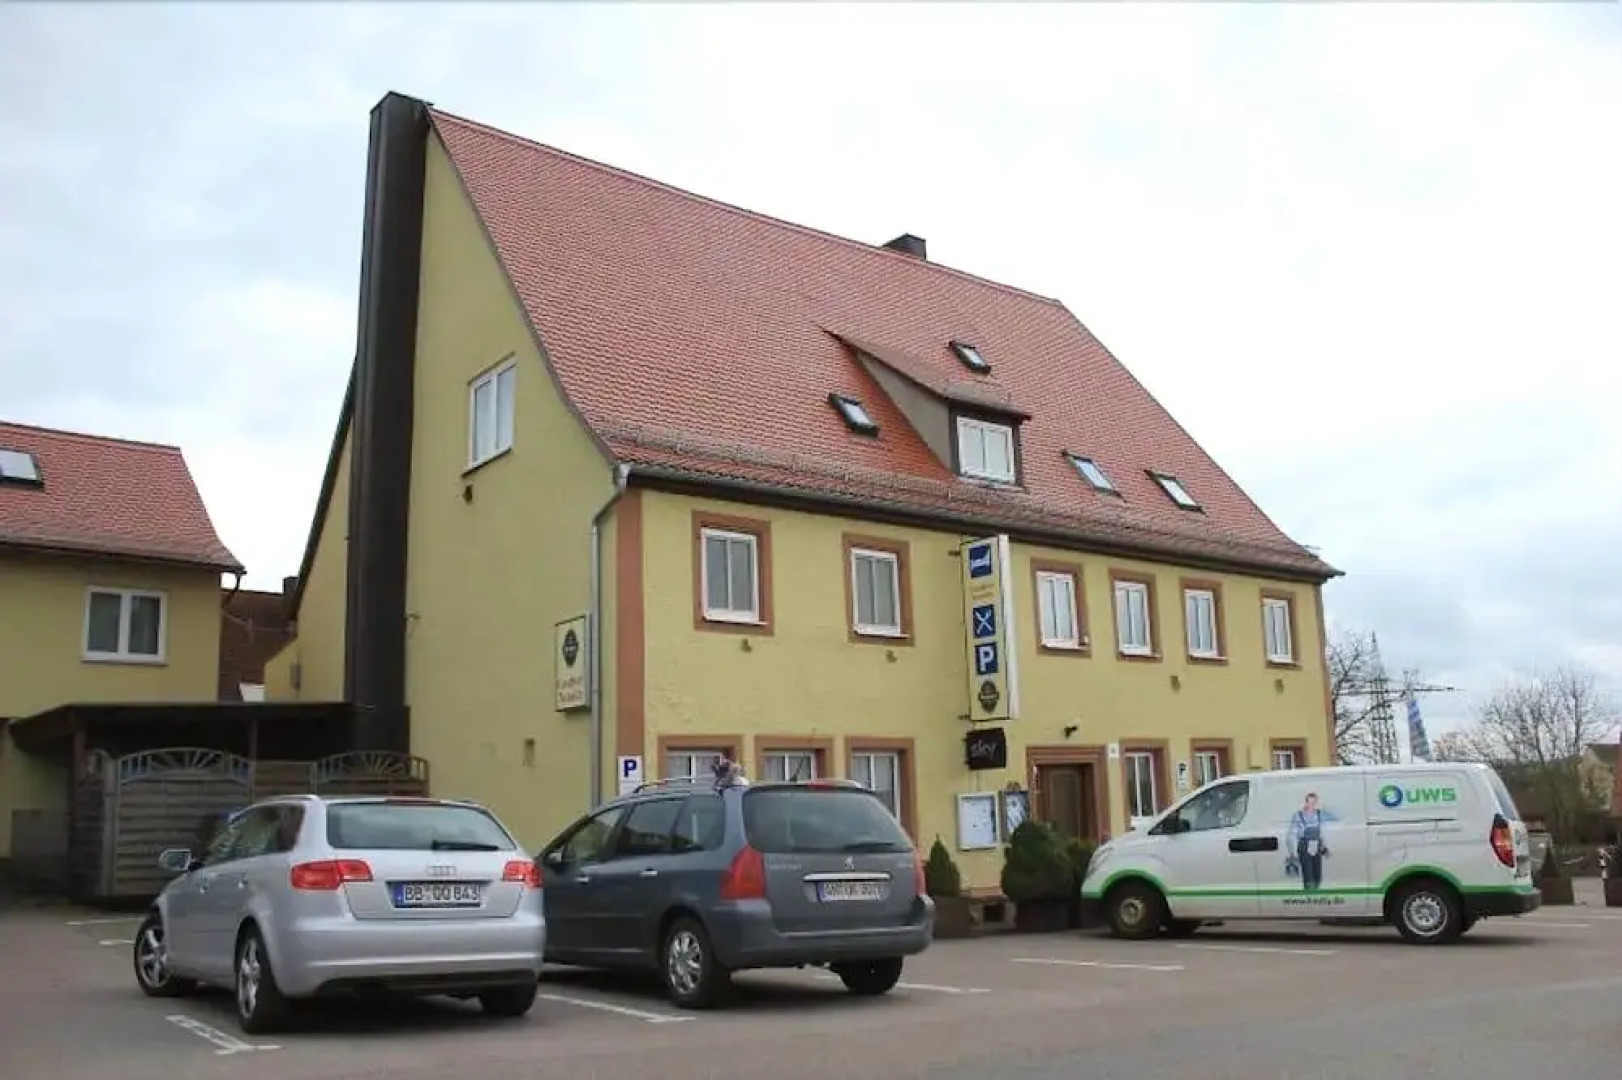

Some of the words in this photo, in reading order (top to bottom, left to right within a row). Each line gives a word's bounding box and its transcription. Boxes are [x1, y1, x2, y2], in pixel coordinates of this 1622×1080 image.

[980, 646, 995, 672] P
[624, 759, 637, 778] P
[1407, 787, 1456, 803] UWS
